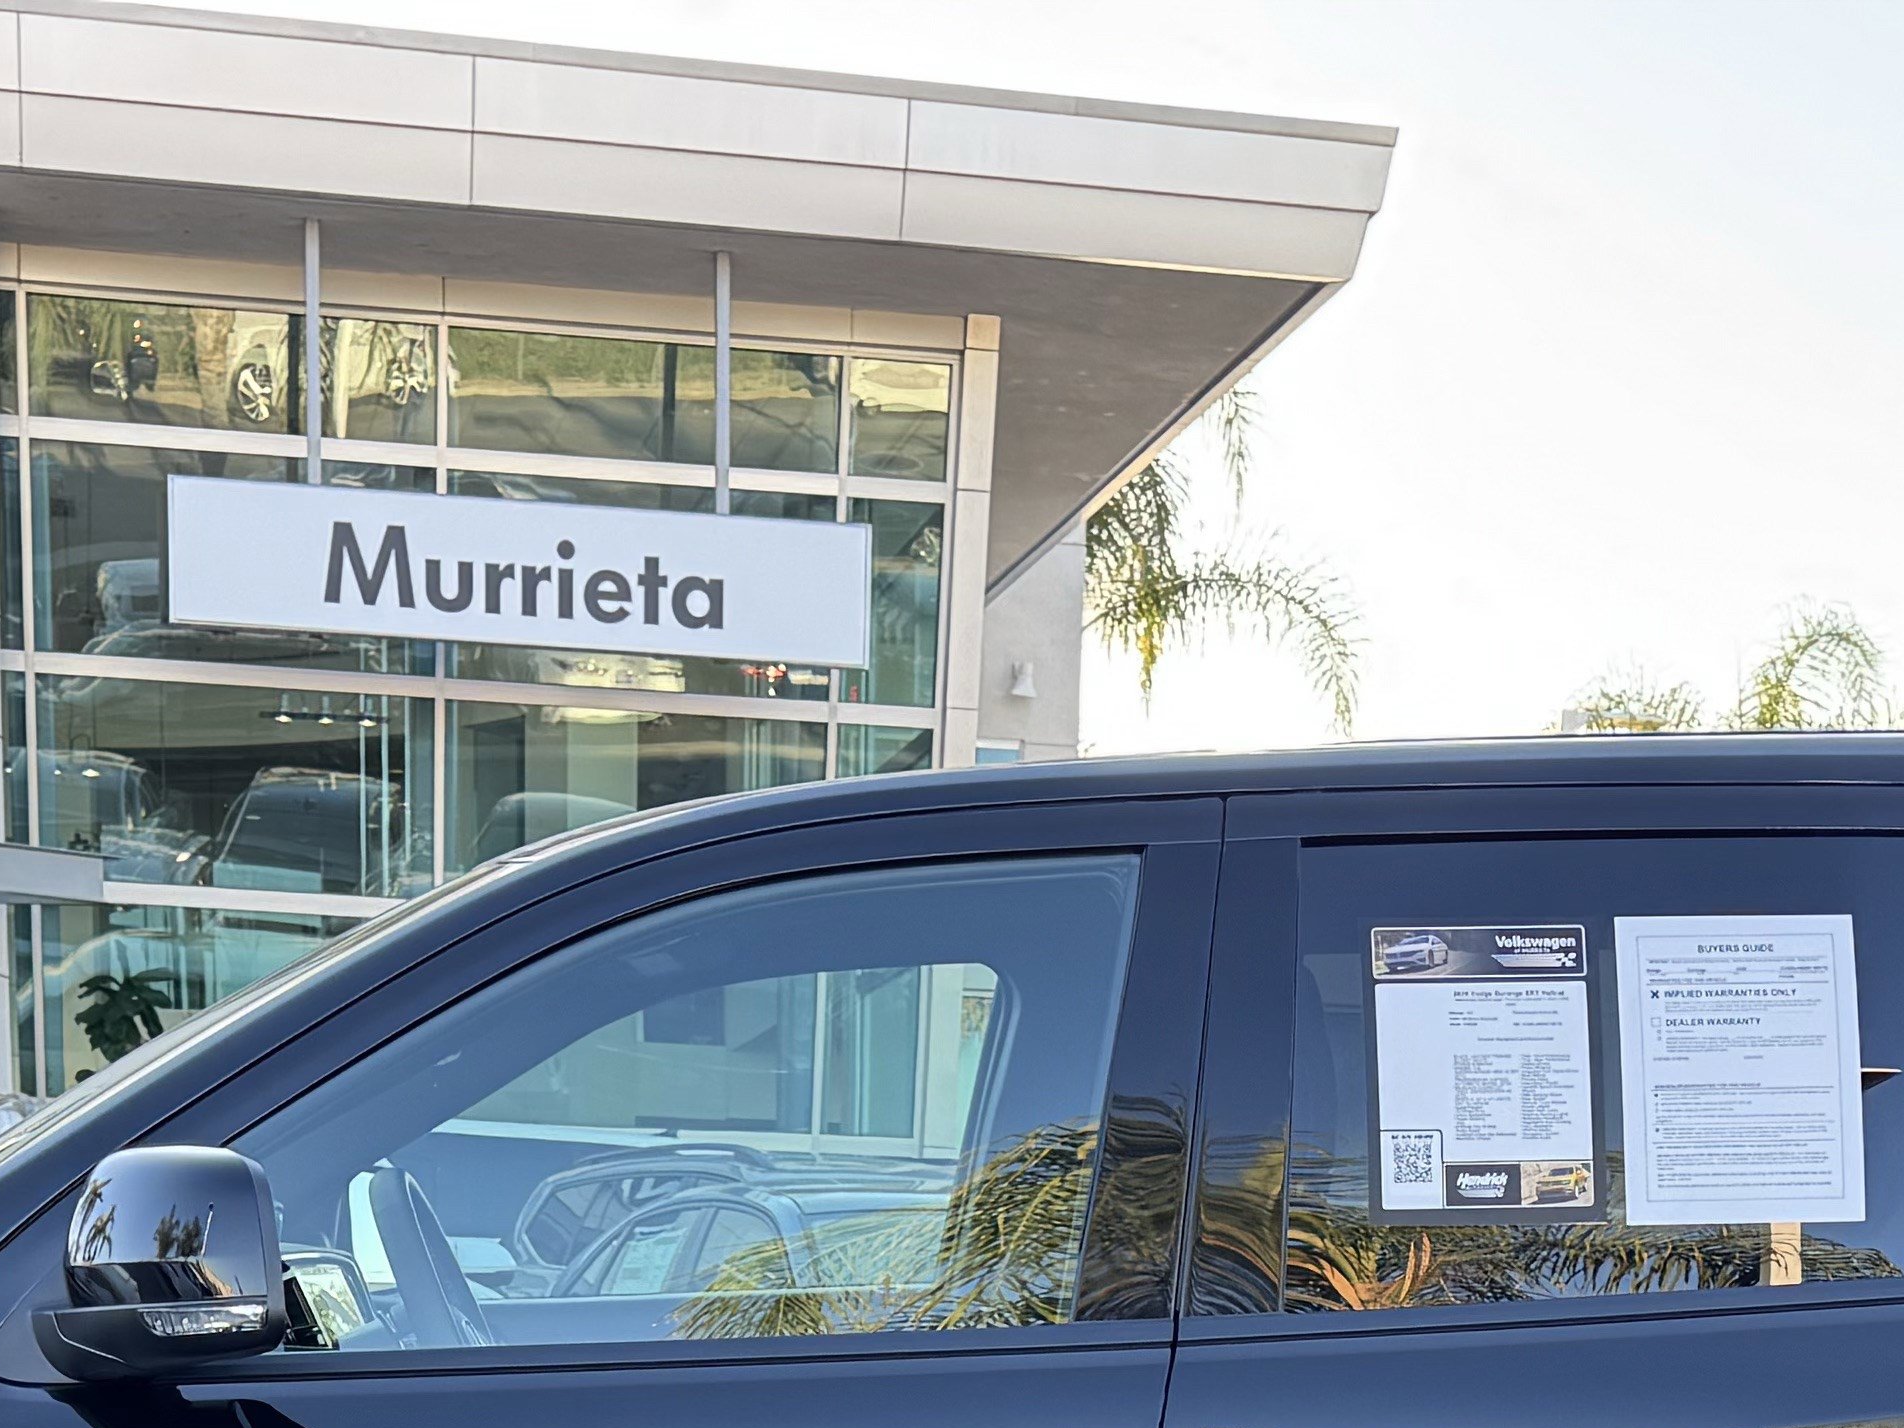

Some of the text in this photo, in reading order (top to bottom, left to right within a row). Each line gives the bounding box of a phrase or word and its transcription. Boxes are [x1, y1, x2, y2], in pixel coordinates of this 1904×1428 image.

[323, 520, 725, 631] Murrieta
[1495, 935, 1577, 950] Volkswagen
[1697, 943, 1774, 953] BUYERS GUIDE
[1665, 1017, 1761, 1027] DEALER WARRANTY
[1456, 1172, 1509, 1190] Hendrick
